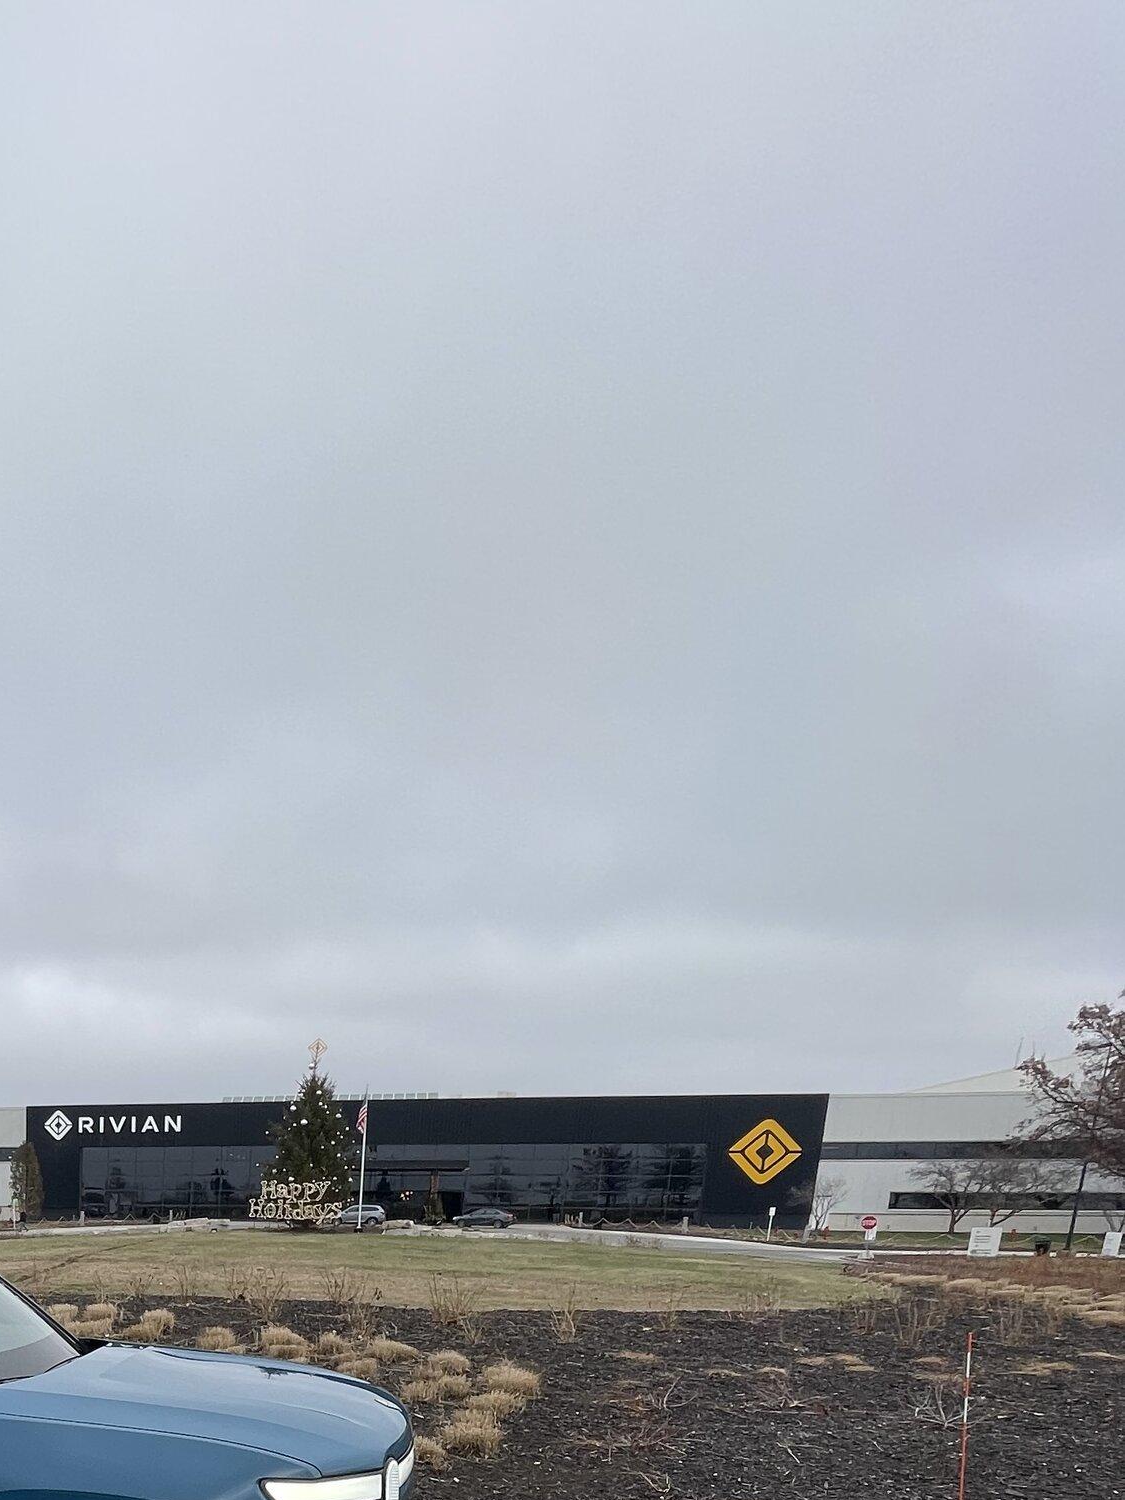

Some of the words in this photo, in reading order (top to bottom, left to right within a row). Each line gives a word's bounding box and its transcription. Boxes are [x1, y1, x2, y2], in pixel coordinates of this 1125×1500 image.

[77, 1115, 182, 1133] RIVIAN
[260, 1180, 331, 1203] Happy
[249, 1199, 342, 1225] Holidays
